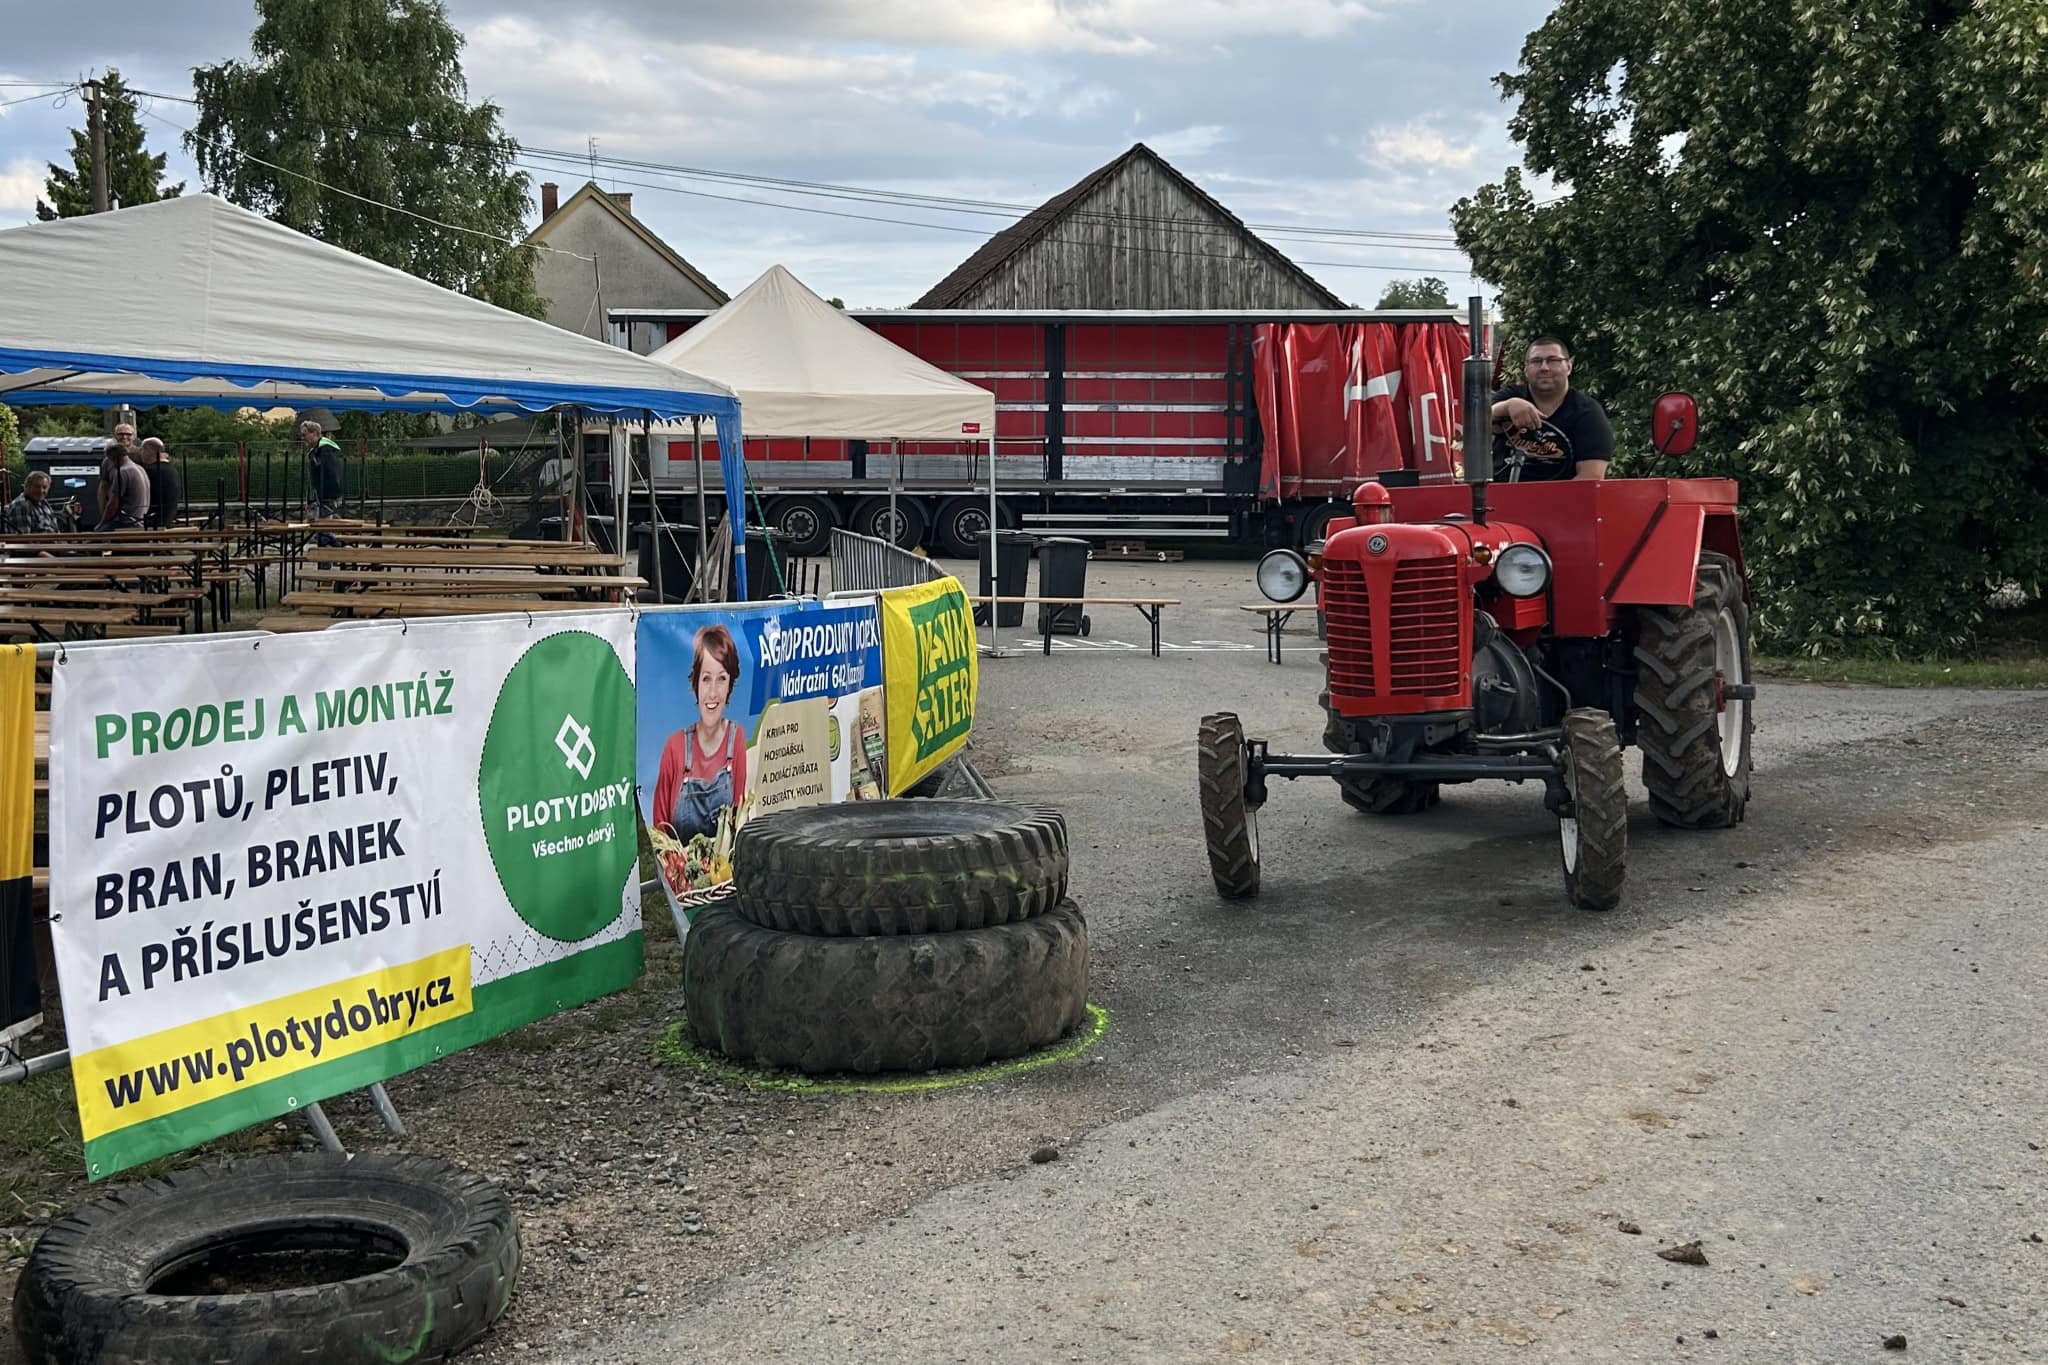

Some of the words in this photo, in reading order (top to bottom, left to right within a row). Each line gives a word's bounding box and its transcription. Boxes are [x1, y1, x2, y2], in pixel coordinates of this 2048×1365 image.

[1087, 550, 1093, 559] 2
[1122, 546, 1128, 554] 1
[1157, 551, 1166, 561] 3
[782, 664, 829, 697] Nádražní
[95, 699, 265, 759] PRODEJ
[278, 694, 307, 737] A
[315, 670, 454, 731] MONTÁŽ
[786, 722, 799, 735] PRO
[94, 764, 254, 839] PLOTŮ,
[264, 752, 399, 811] PLETIV,
[762, 773, 768, 784] A
[532, 834, 584, 858] Všechno
[587, 822, 616, 845] dobrý!
[94, 852, 236, 919] BRAN,
[247, 818, 405, 888] BRANEK
[98, 952, 131, 1001] A
[143, 869, 441, 989] PŘÍSLUŠENSTVÍ
[105, 974, 454, 1108] www.plotydobry.cz
